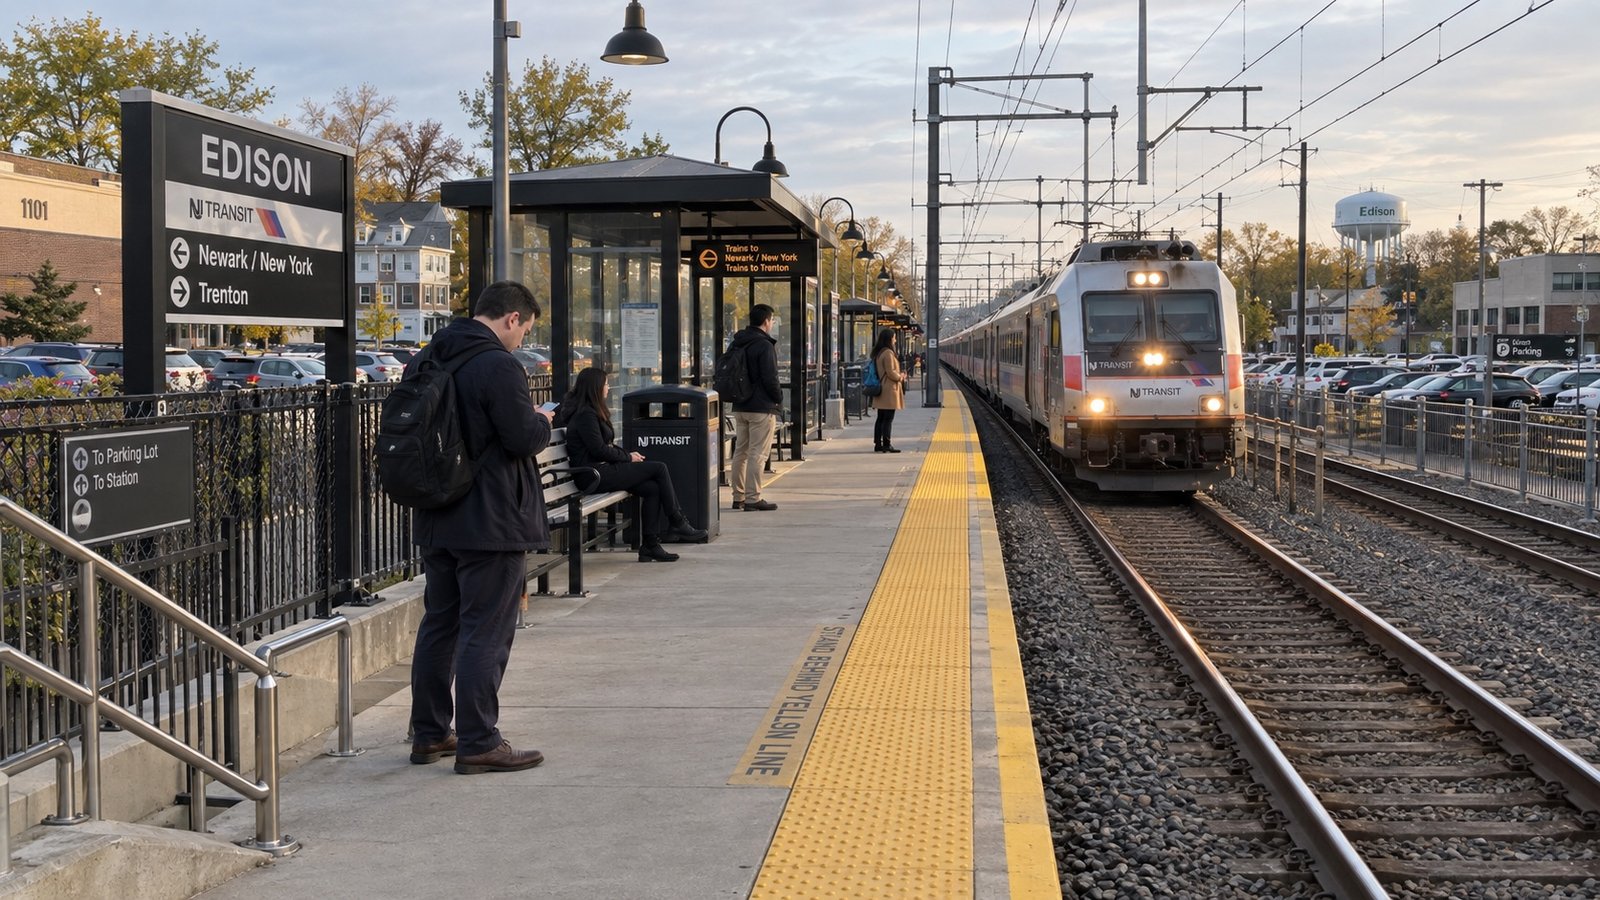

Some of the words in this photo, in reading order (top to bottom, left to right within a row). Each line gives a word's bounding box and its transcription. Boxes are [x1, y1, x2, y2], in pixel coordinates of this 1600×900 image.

[201, 133, 311, 196] EDISON
[20, 197, 48, 221] 1101
[189, 197, 203, 220] NJ
[205, 200, 254, 224] TRANSIT
[1360, 206, 1395, 216] Edison
[725, 244, 749, 253] Trains
[750, 244, 759, 253] to
[199, 243, 249, 270] Newark
[251, 250, 257, 272] /
[260, 251, 287, 273] New
[289, 255, 313, 276] York
[725, 253, 755, 263] Newark
[761, 253, 779, 263] New
[780, 253, 798, 263] York
[725, 263, 749, 272] Trains
[750, 263, 759, 272] to
[760, 263, 790, 272] Trenton
[199, 281, 249, 305] Trenton
[1512, 346, 1542, 358] Parking
[1099, 360, 1134, 369] TRANSIT
[1130, 387, 1141, 398] NJ
[1142, 387, 1182, 396] TRANSIT
[638, 436, 649, 447] NJ
[649, 436, 691, 446] TRANSIT
[92, 449, 105, 465] To
[107, 446, 142, 464] Parking
[144, 444, 159, 460] Lot
[93, 474, 105, 490] To
[107, 470, 139, 488] Station
[745, 744, 793, 776] LINE
